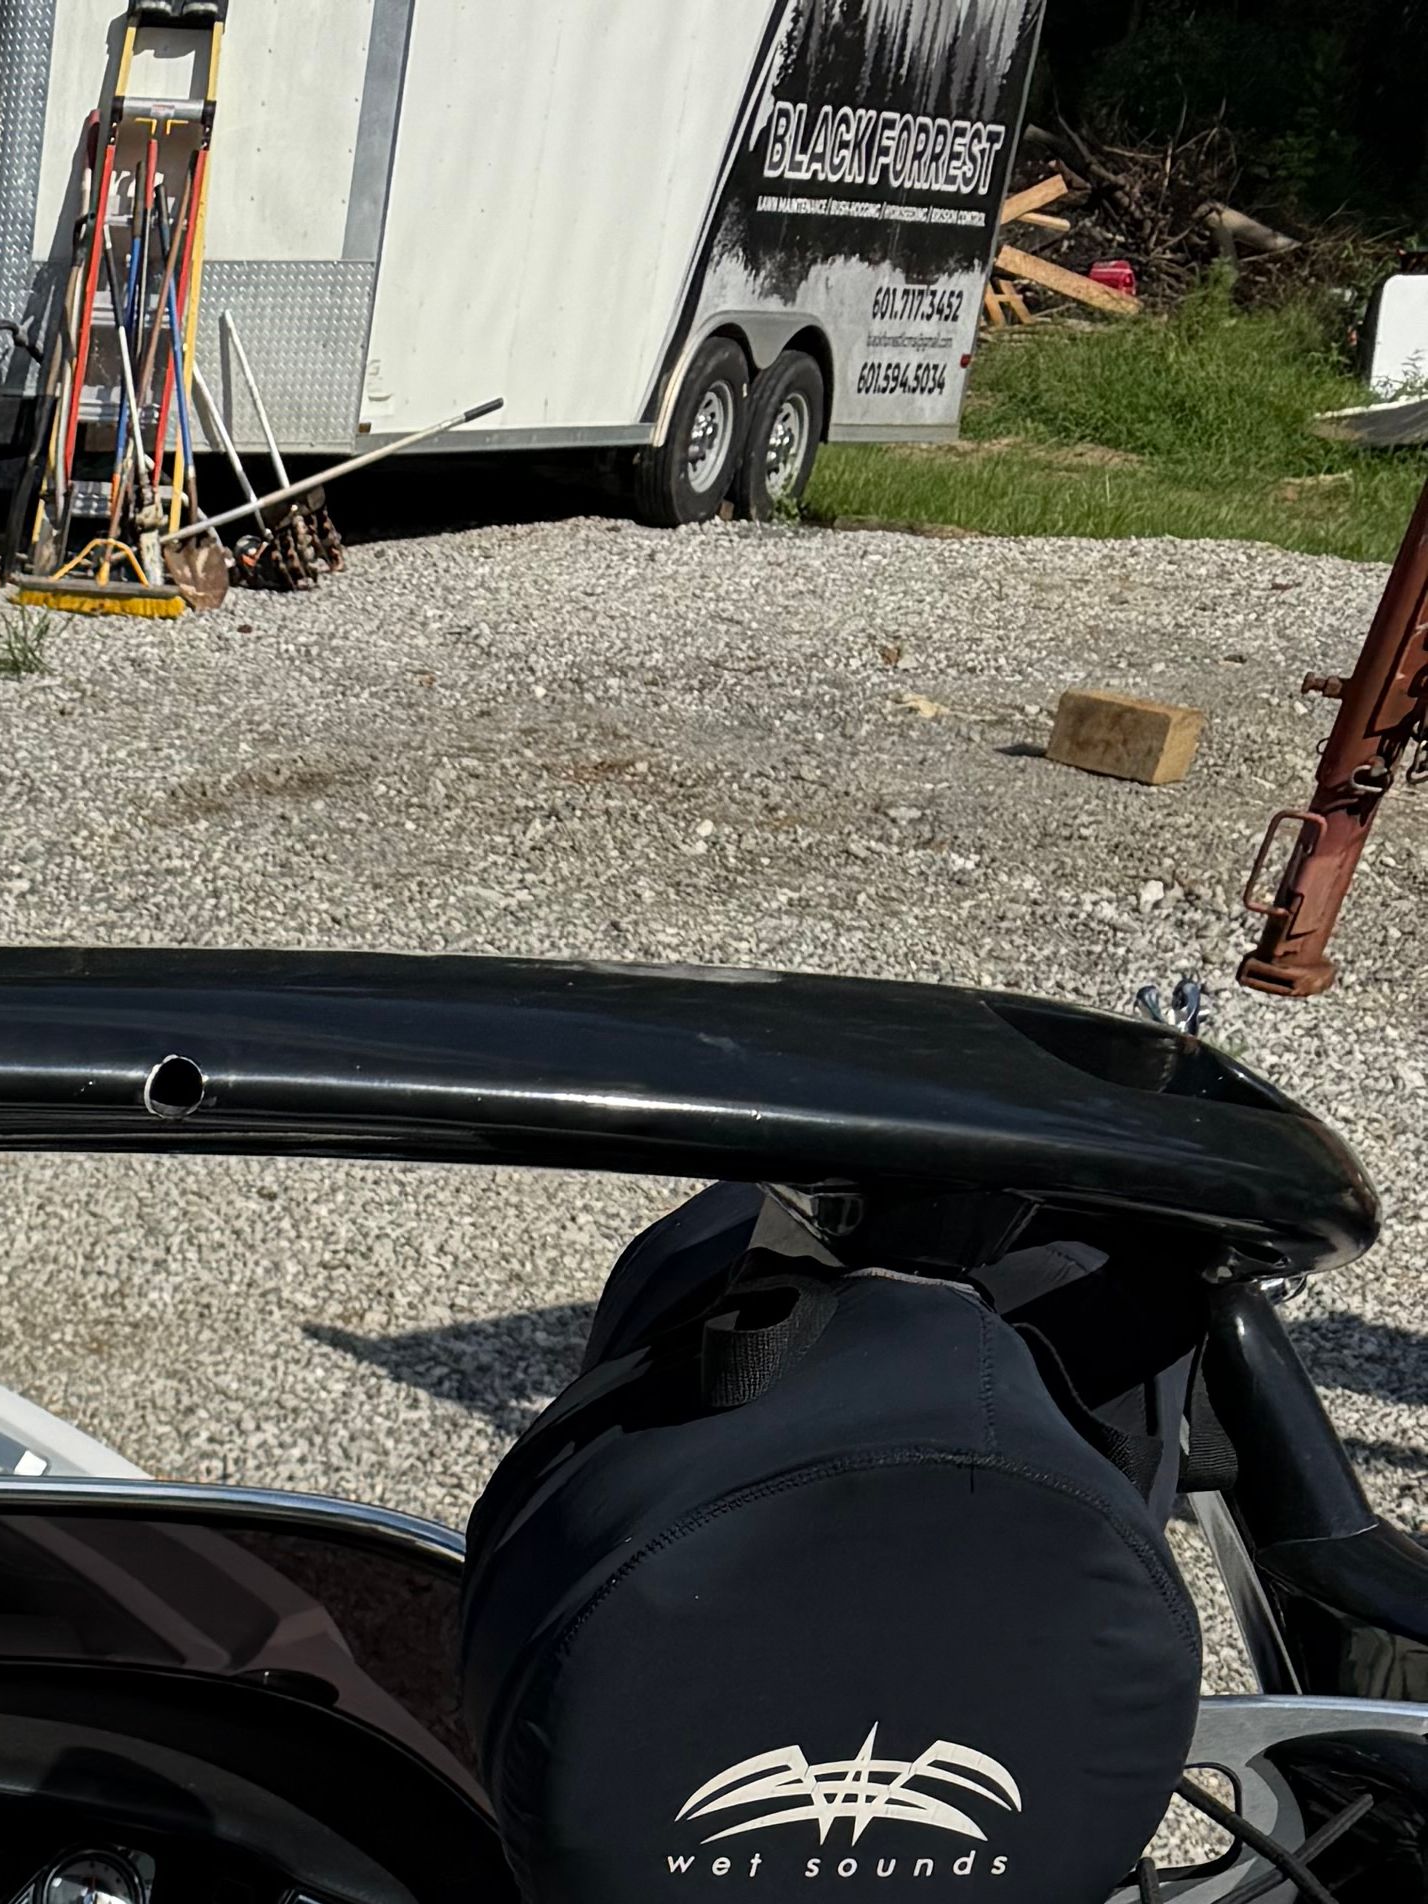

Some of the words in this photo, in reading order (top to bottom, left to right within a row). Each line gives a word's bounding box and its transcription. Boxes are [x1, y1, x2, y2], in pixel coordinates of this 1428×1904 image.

[764, 101, 876, 184] BLACK
[869, 111, 1006, 195] FORREST
[756, 195, 779, 213] LAWN
[872, 286, 963, 322] 601.717.3452
[857, 361, 947, 395] 601.594.5034
[667, 1853, 763, 1878] wet
[804, 1850, 1009, 1879] sounds
